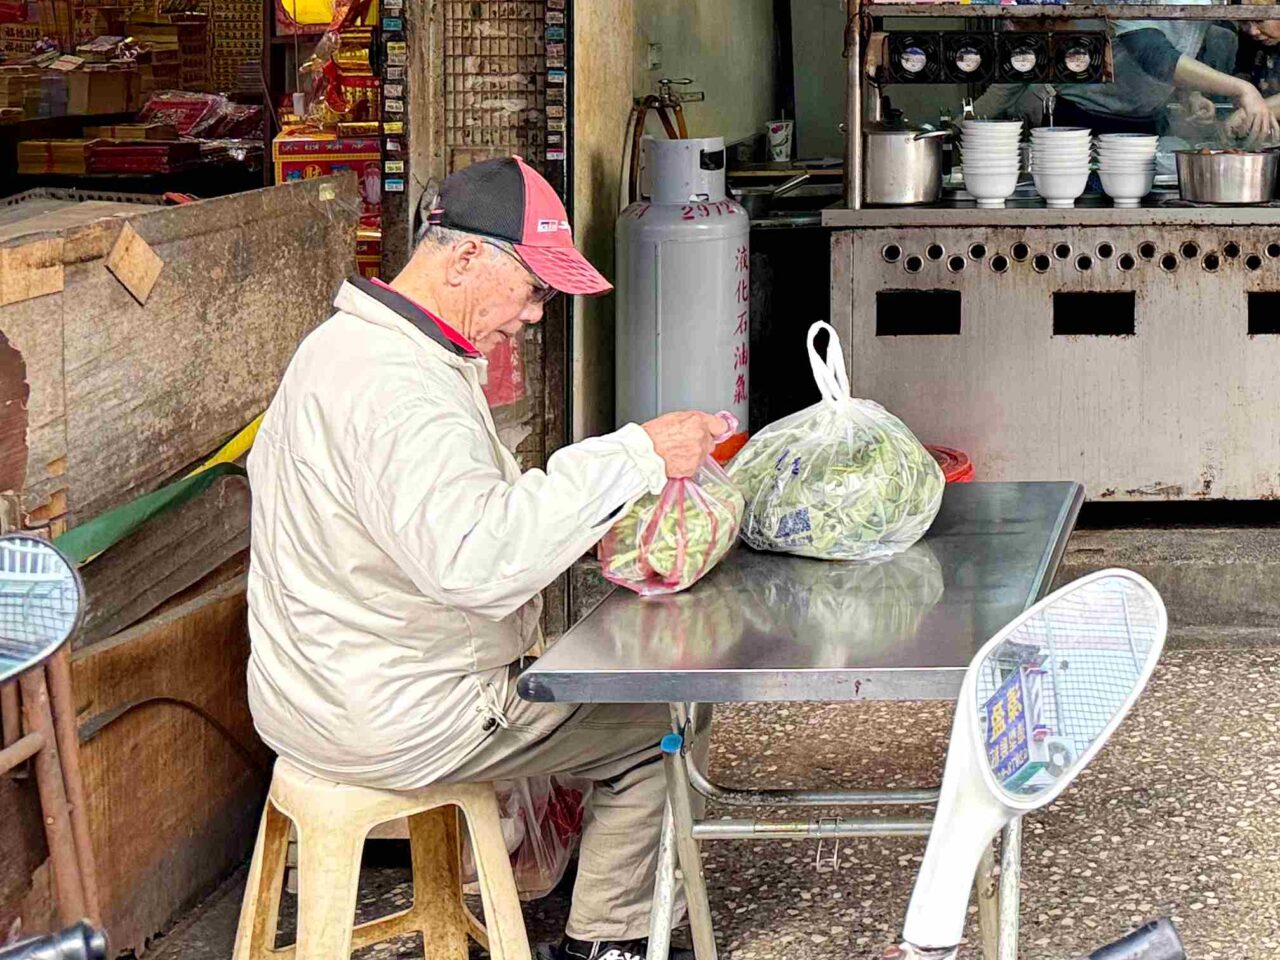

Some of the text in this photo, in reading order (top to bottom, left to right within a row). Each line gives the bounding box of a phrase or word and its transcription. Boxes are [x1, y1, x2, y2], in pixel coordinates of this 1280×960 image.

[733, 247, 749, 405] 液化石油氣
